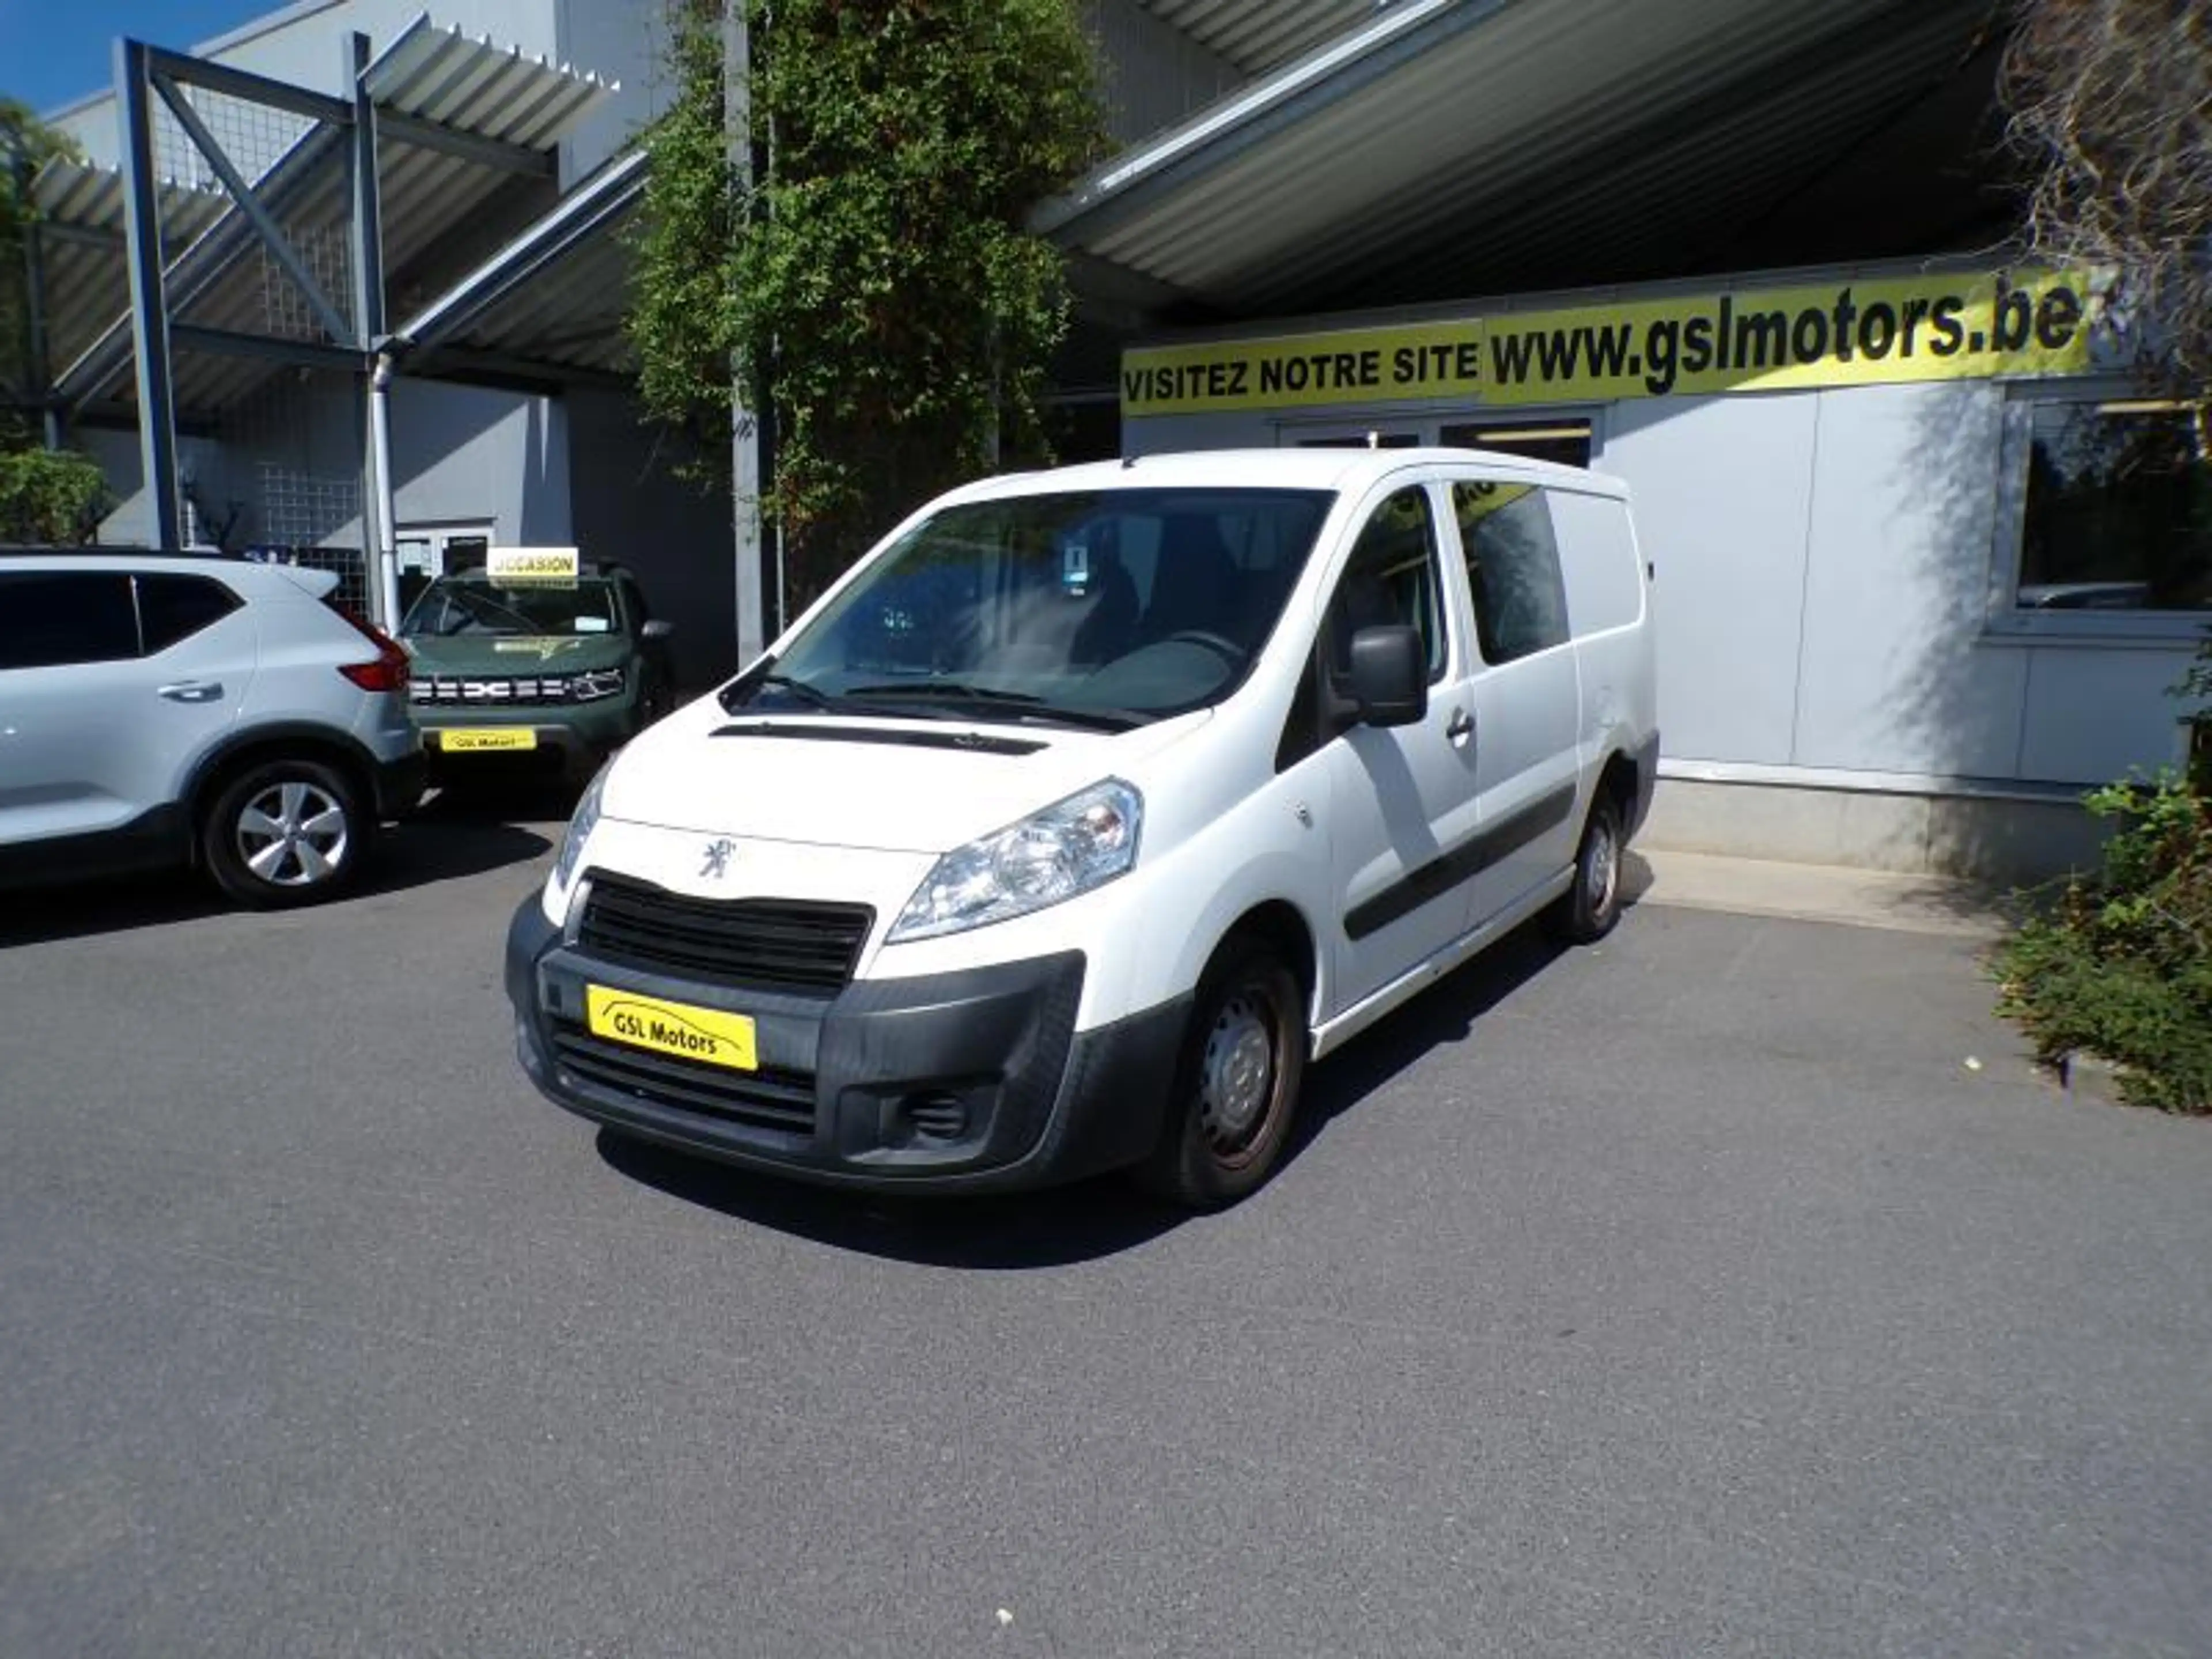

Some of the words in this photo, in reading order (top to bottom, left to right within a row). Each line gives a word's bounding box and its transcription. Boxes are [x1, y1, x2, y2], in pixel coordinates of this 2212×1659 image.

[1491, 272, 2081, 394] www.gslmotors.be
[1124, 362, 1248, 402] VISITEZ
[1260, 350, 1380, 393] NOTRE
[1393, 344, 1478, 384] SITE
[613, 1013, 646, 1038] GSL
[650, 1020, 717, 1055] Motors
